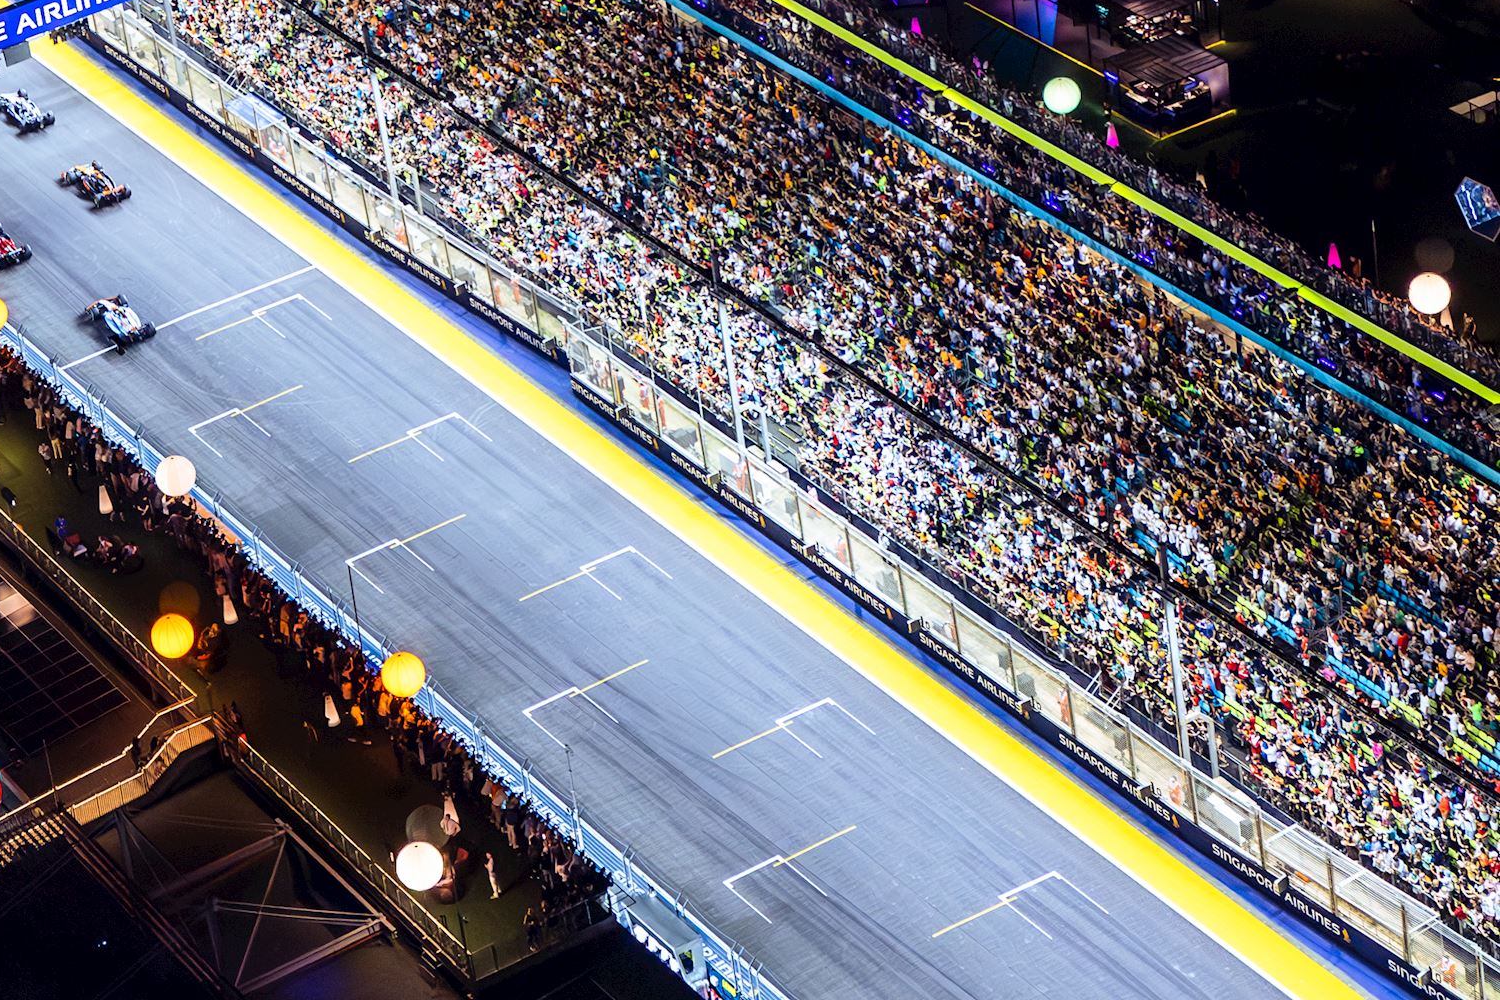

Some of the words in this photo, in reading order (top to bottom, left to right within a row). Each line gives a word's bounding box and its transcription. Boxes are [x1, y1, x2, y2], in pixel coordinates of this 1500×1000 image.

[272, 165, 310, 197] SINGAPORE
[311, 193, 341, 219] AIRLINES
[363, 230, 406, 264] SGAPORE
[407, 258, 441, 287] AIRLINES
[469, 297, 513, 332] SINGAPORE
[571, 380, 615, 419] SINGAPORE
[720, 489, 759, 523] AIRLINES
[844, 578, 886, 615] AIRLINES
[919, 633, 975, 679] SINGAPORE
[977, 674, 1024, 714] AIRLINES
[1059, 733, 1119, 783] SINGAPORE
[1284, 892, 1341, 936] AIRLINES
